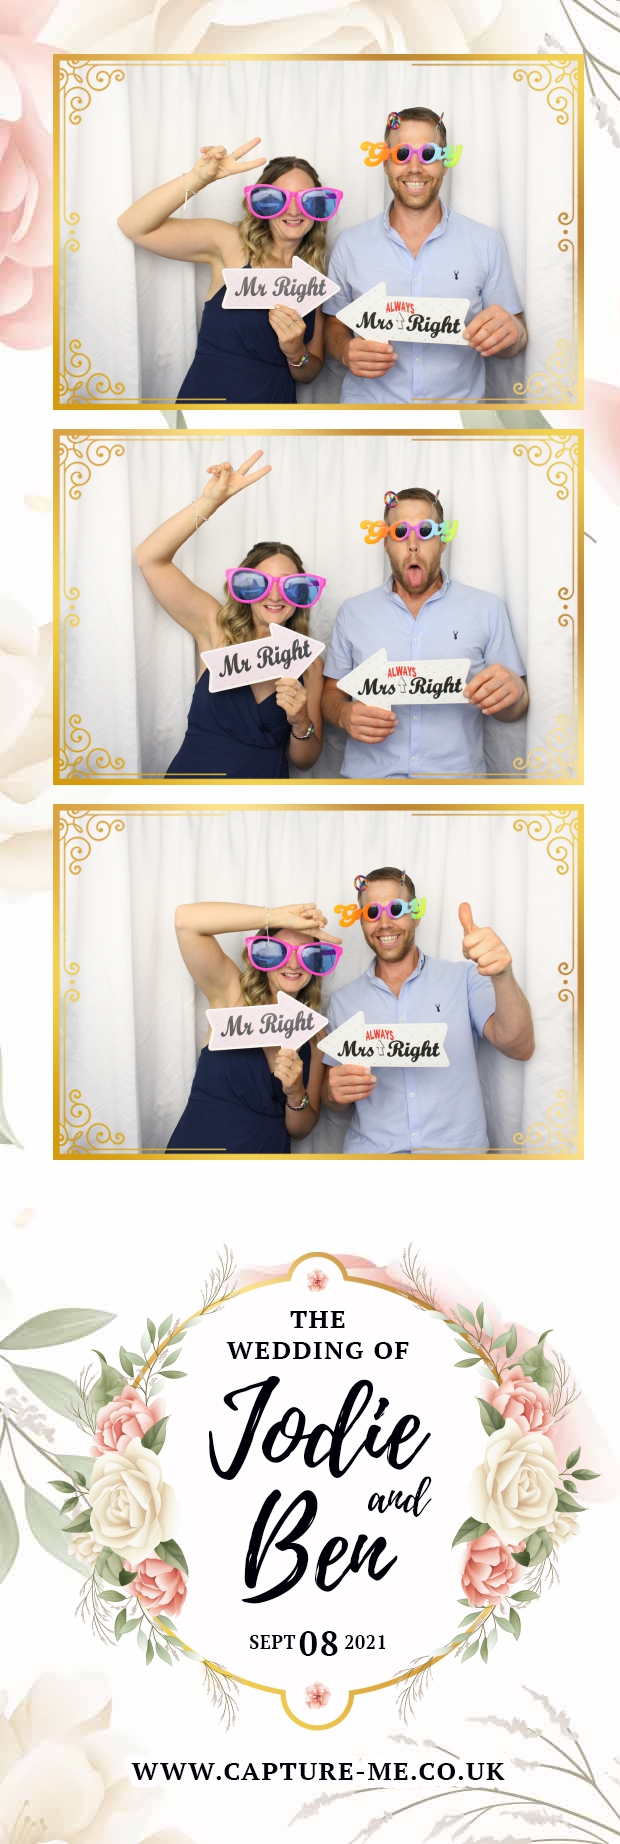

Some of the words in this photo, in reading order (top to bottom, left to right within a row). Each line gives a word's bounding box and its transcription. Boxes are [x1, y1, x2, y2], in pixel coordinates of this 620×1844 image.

[234, 276, 267, 297] Mr
[272, 276, 327, 303] Right
[385, 301, 415, 314] ALWAYS
[356, 311, 393, 330] Mrs
[406, 314, 461, 338] Right
[218, 652, 252, 678] Mr
[256, 639, 312, 670] Right
[387, 666, 417, 679] ALWAYS
[357, 678, 396, 695] Mrs
[408, 675, 463, 699] Right
[220, 1015, 254, 1037] Mr
[259, 1010, 315, 1039] Right
[365, 1028, 394, 1041] ALWAYS
[337, 1040, 374, 1057] Mrs
[387, 1040, 440, 1062] Right
